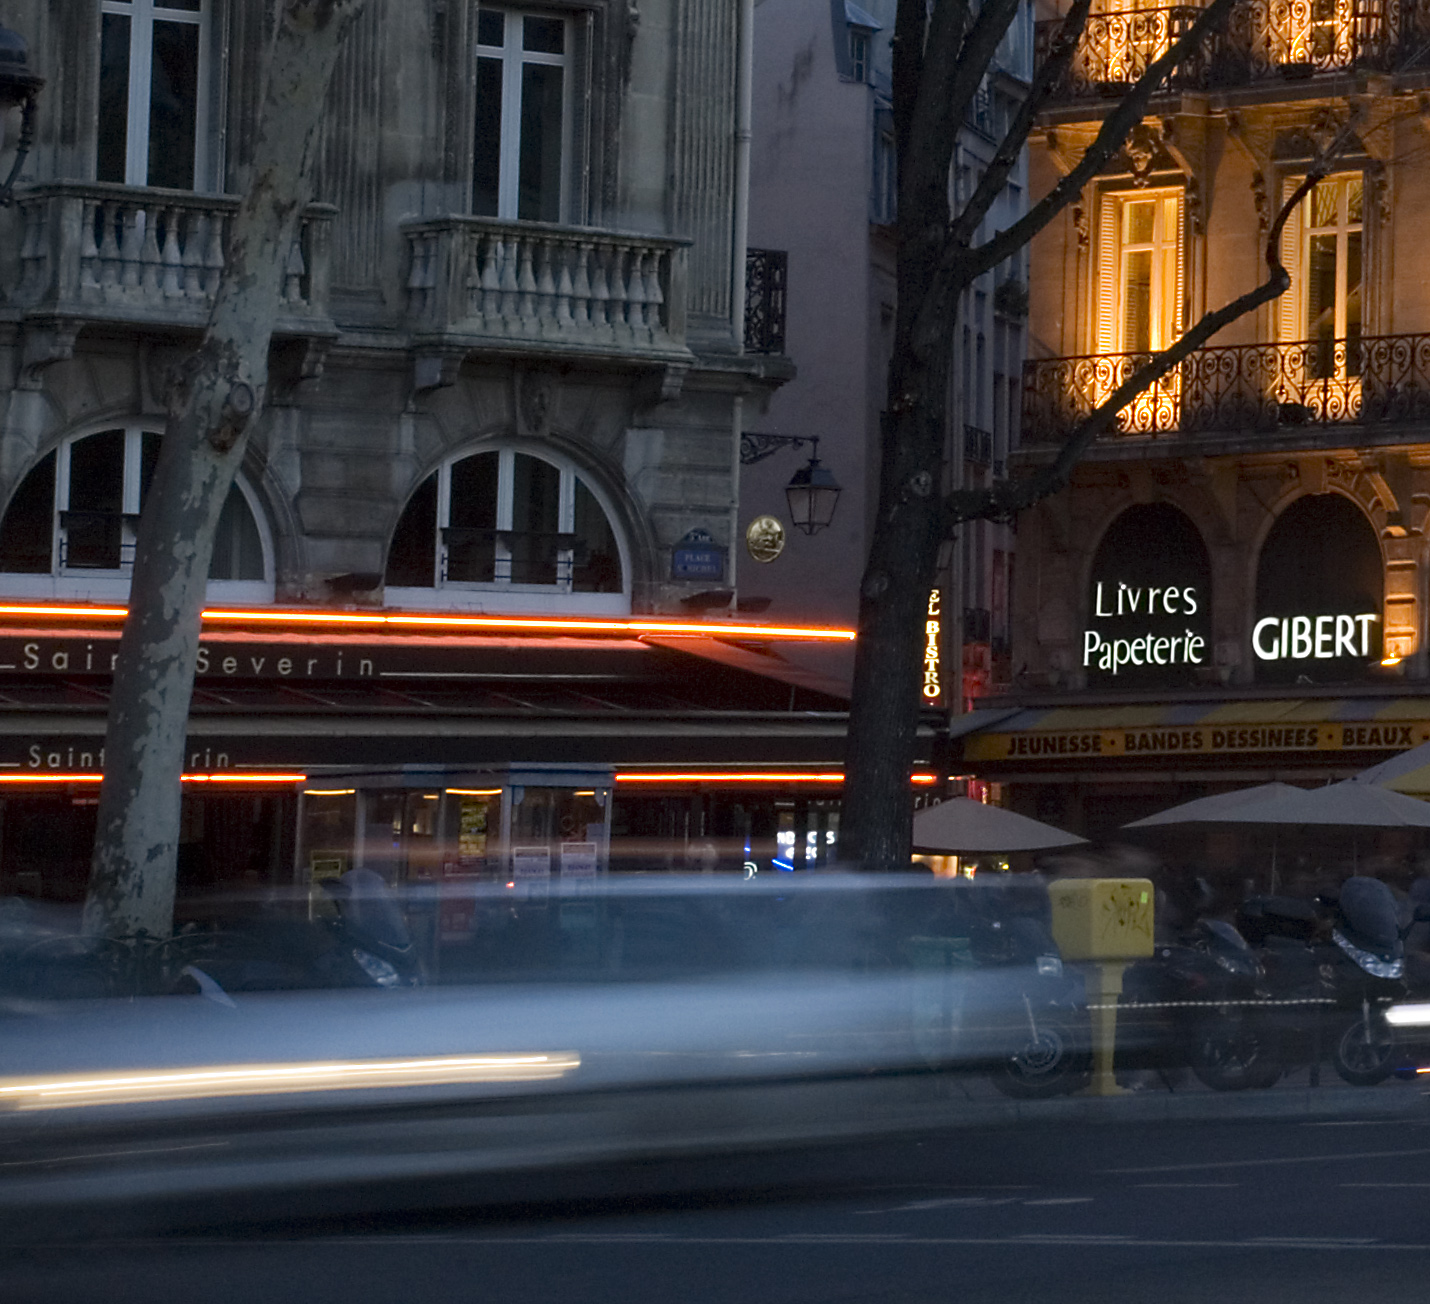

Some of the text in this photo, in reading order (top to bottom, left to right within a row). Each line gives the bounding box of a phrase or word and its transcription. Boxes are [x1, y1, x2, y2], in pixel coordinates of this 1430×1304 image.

[685, 554, 711, 562] PLACE
[1094, 581, 1198, 618] Livres
[1083, 628, 1205, 675] Papeterie
[1251, 613, 1382, 661] GIBERT
[195, 650, 375, 677] Severin
[923, 620, 941, 698] BISTRO
[1007, 725, 1414, 756] JEUNESSE BANDES DESSINEES BEAUX
